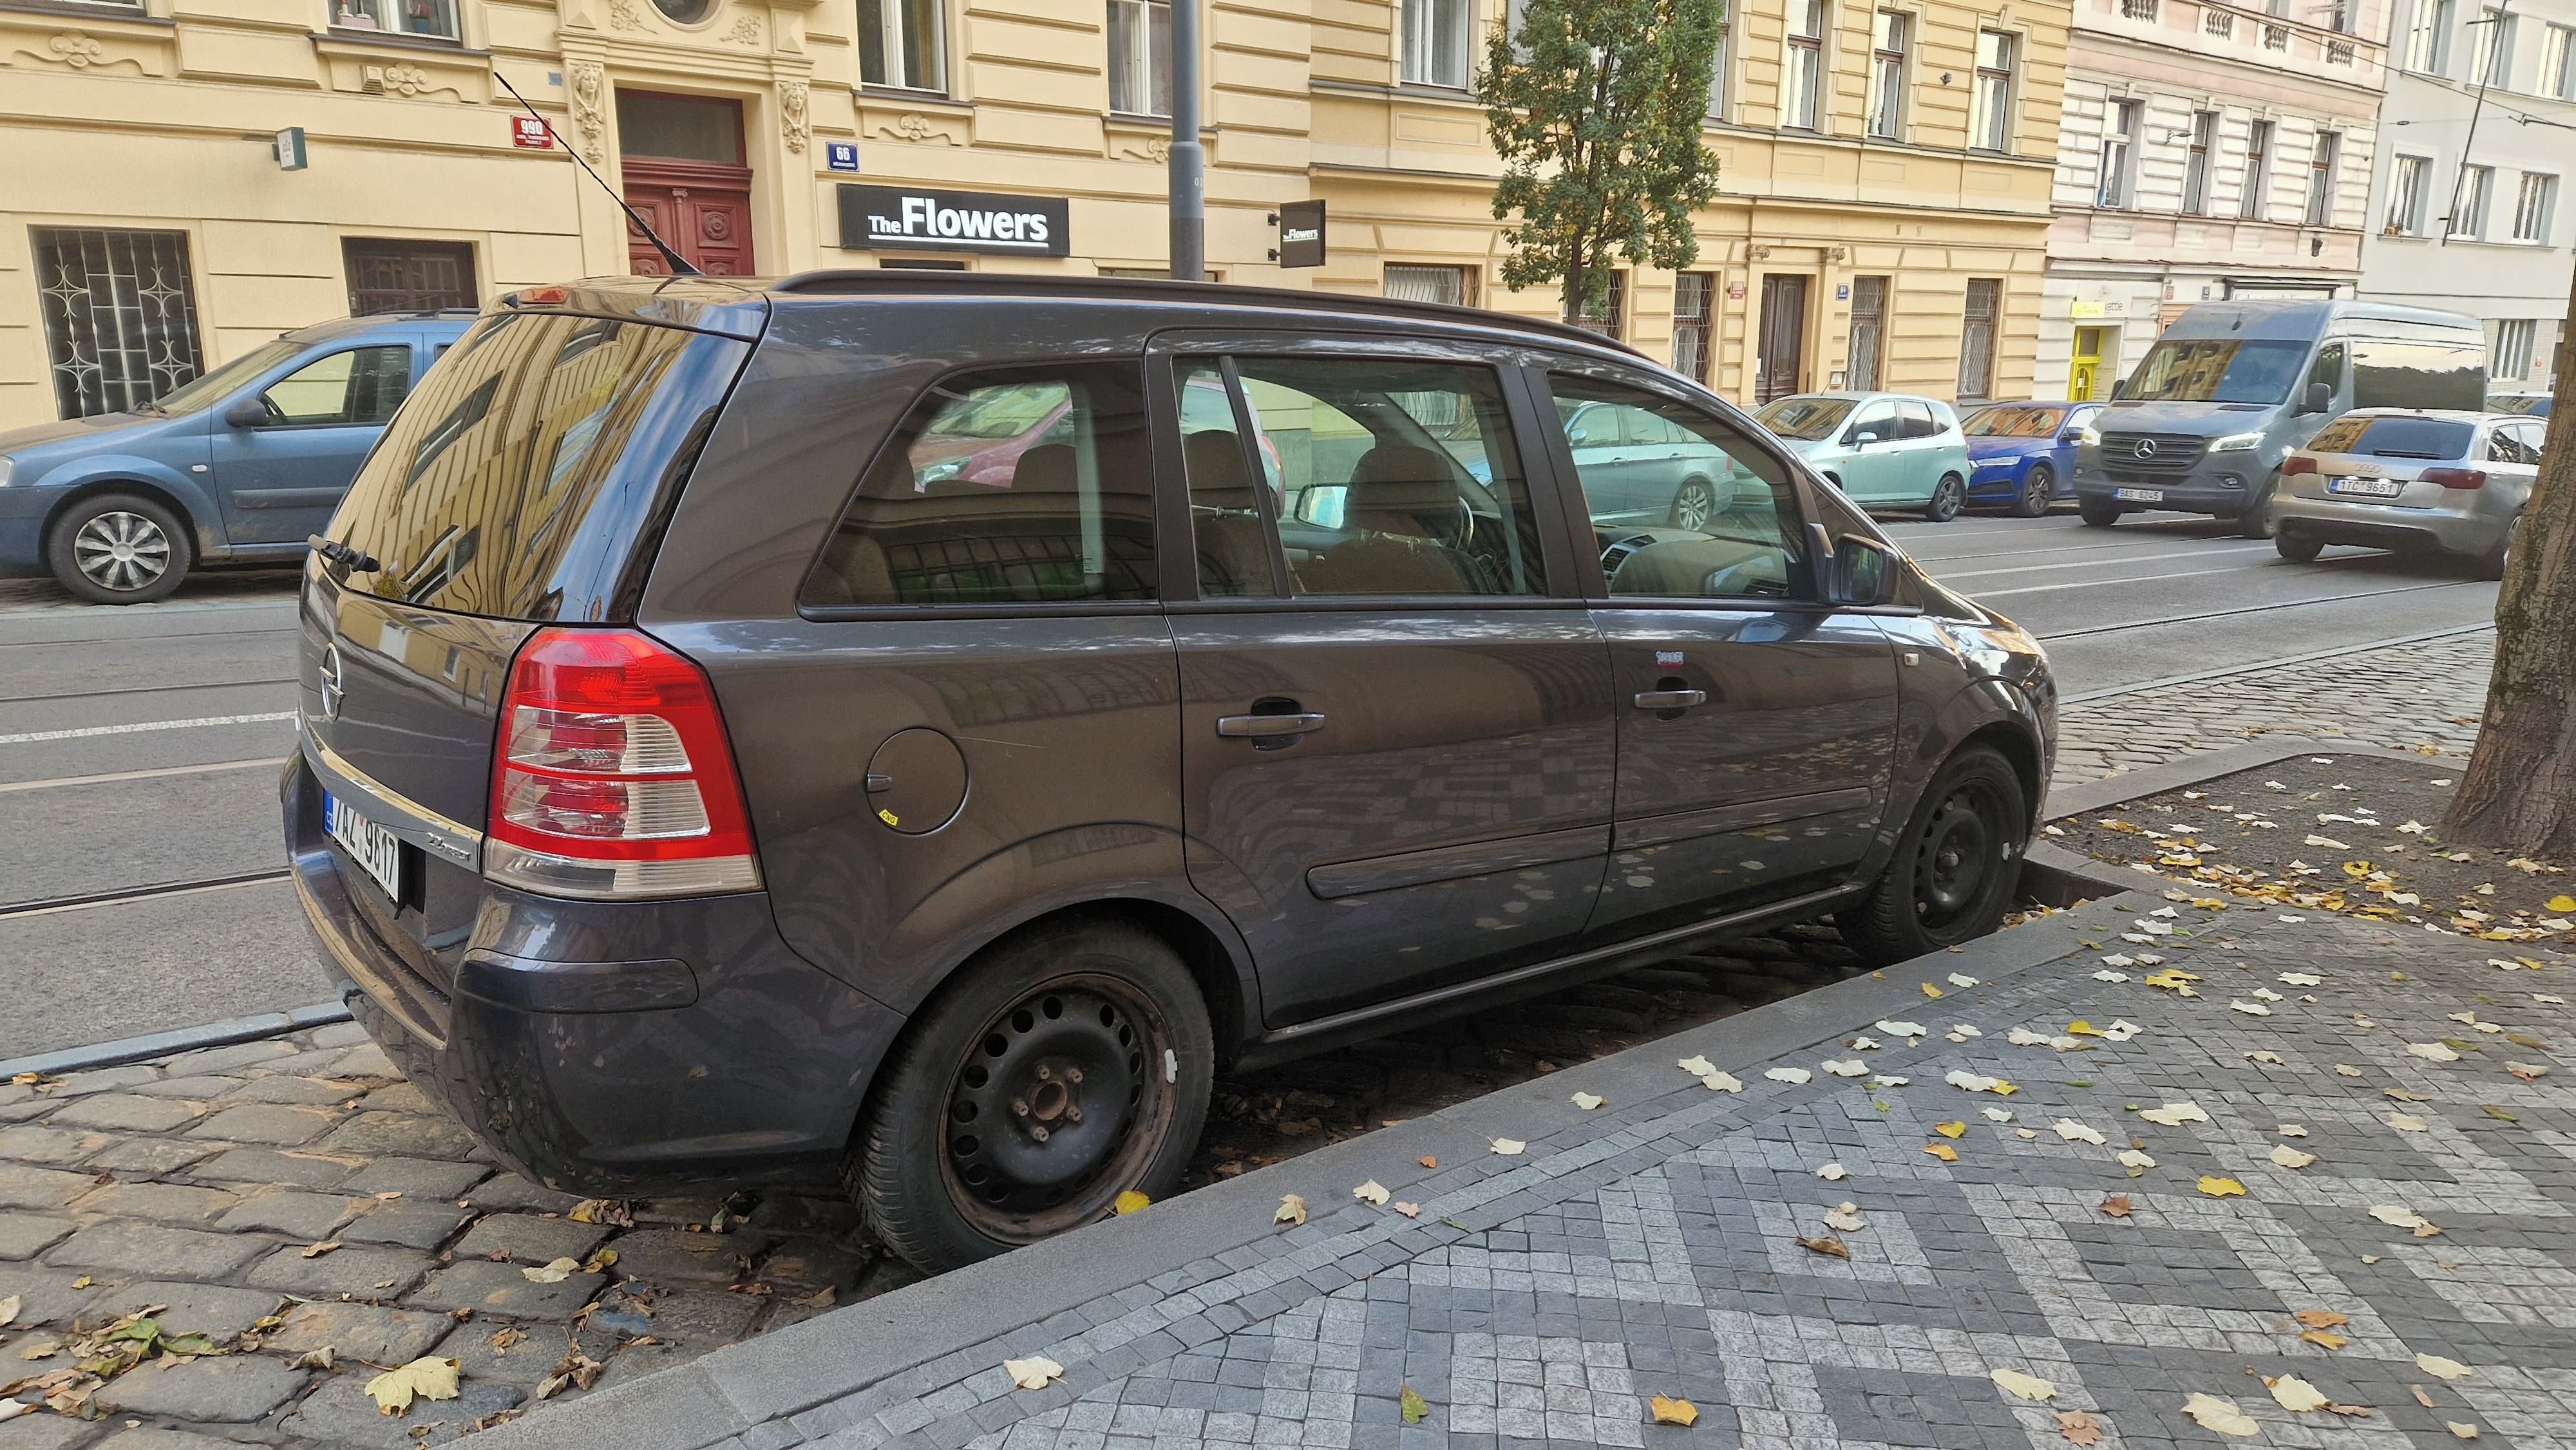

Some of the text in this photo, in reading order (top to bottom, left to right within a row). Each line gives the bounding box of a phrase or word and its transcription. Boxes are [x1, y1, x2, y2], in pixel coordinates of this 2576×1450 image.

[520, 120, 543, 135] 990
[836, 146, 850, 161] 66
[868, 196, 1048, 241] The Flowers
[1289, 229, 1318, 239] Flowers
[2105, 299, 2123, 312] attle
[2341, 481, 2393, 494] 1TC 9651
[882, 811, 896, 824] CNG
[365, 820, 395, 885] 9617
